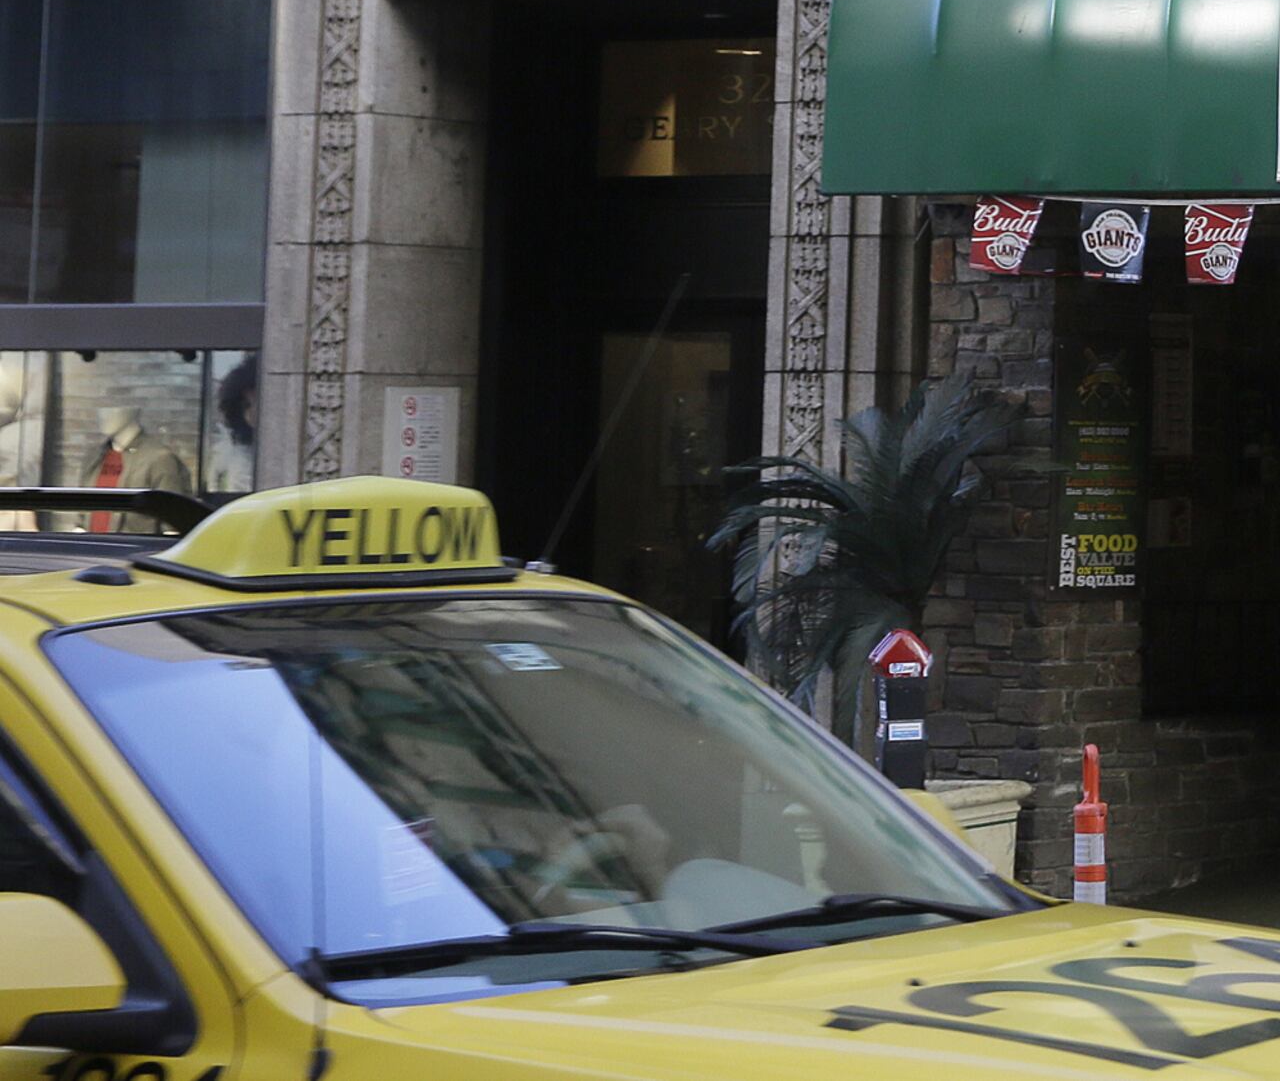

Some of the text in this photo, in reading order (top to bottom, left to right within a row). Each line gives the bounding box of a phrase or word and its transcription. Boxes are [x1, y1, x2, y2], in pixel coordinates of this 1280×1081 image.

[1086, 230, 1141, 252] GIANTS
[281, 505, 491, 567] YELLOW
[1077, 535, 1138, 552] FOOD
[1059, 534, 1077, 587] BEST
[1078, 553, 1136, 566] VALUE
[1094, 566, 1115, 575] THE
[1076, 574, 1136, 590] SQUARE
